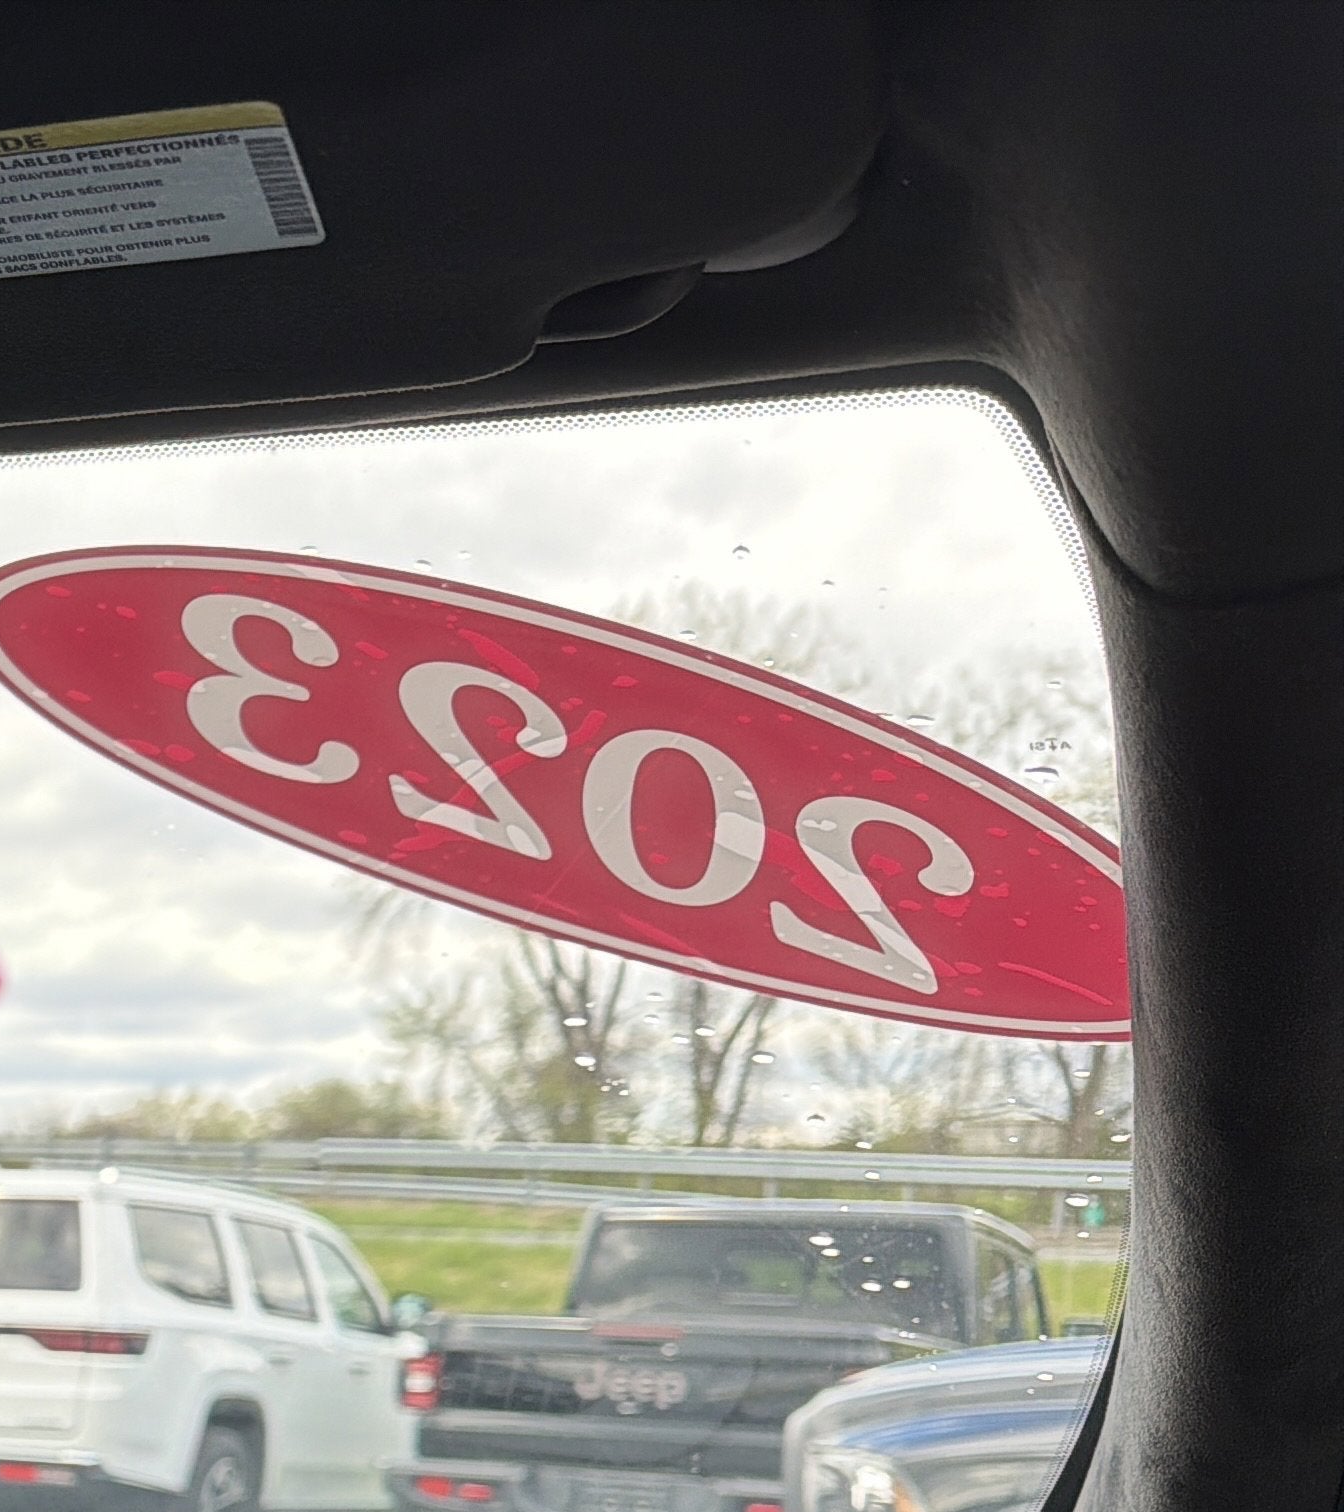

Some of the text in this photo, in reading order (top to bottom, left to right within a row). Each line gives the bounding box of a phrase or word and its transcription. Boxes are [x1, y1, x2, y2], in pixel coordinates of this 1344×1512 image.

[75, 133, 240, 161] PERFECTIONNÉS
[155, 156, 181, 165] PAR
[574, 1361, 688, 1411] Jeep
